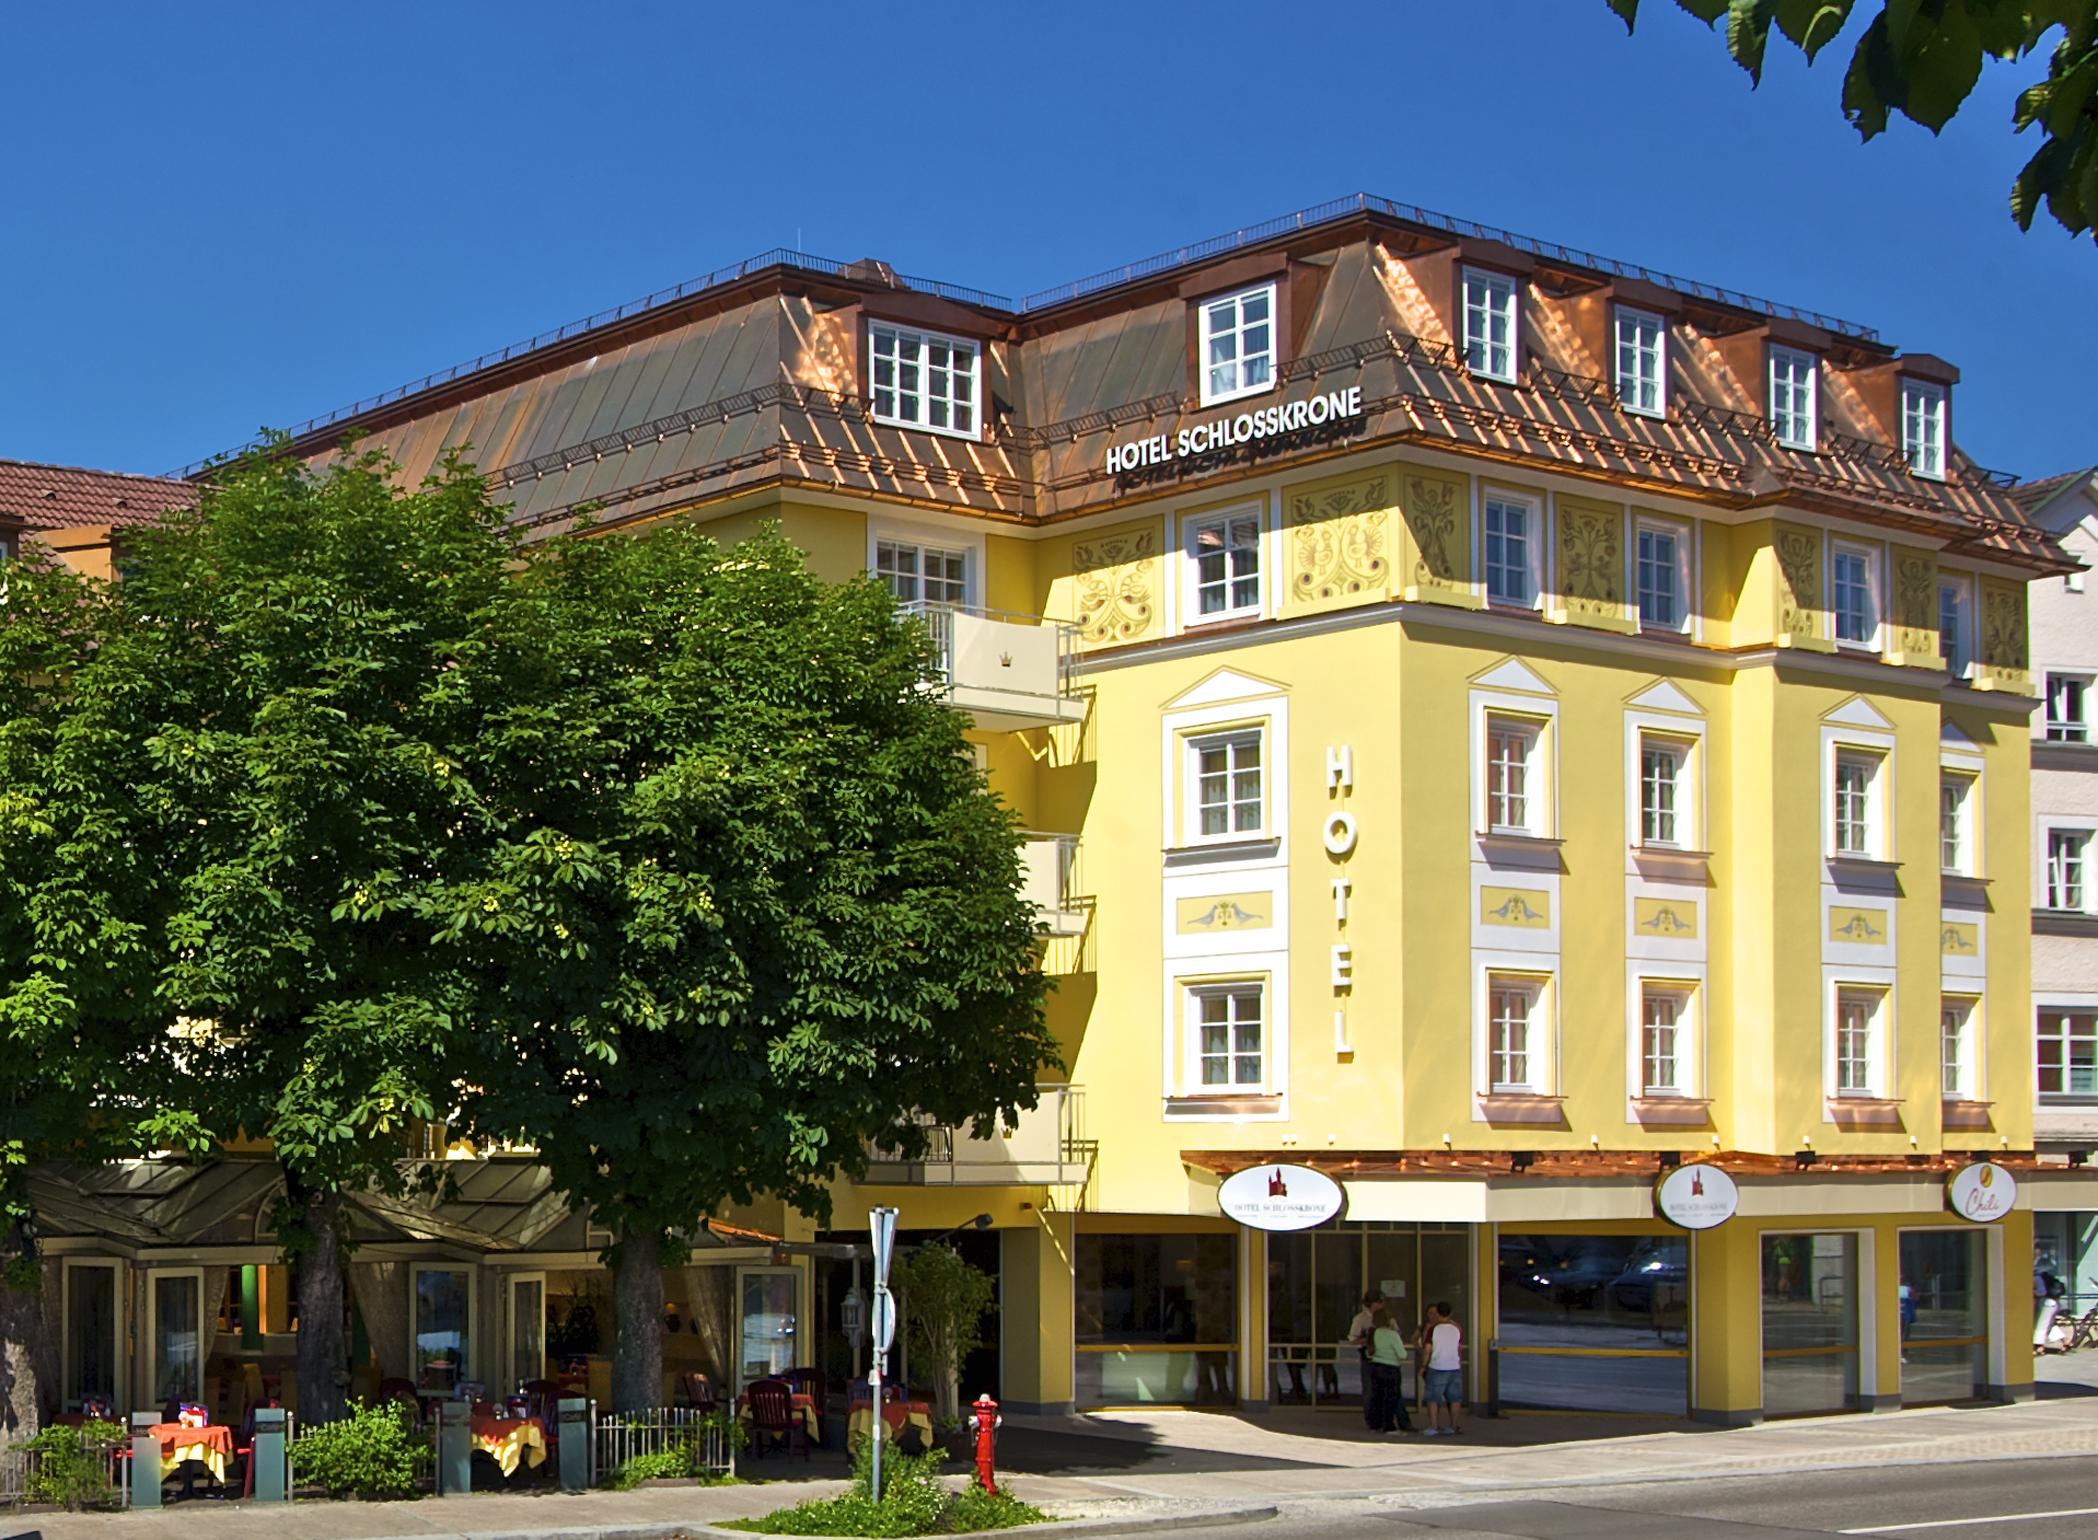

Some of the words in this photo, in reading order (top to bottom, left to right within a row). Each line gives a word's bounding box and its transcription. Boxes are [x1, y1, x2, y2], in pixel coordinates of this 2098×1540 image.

[1106, 434, 1172, 474] HOTEL
[1178, 387, 1362, 457] SCHLOSSKRONE
[1323, 744, 1356, 1054] HOTEL
